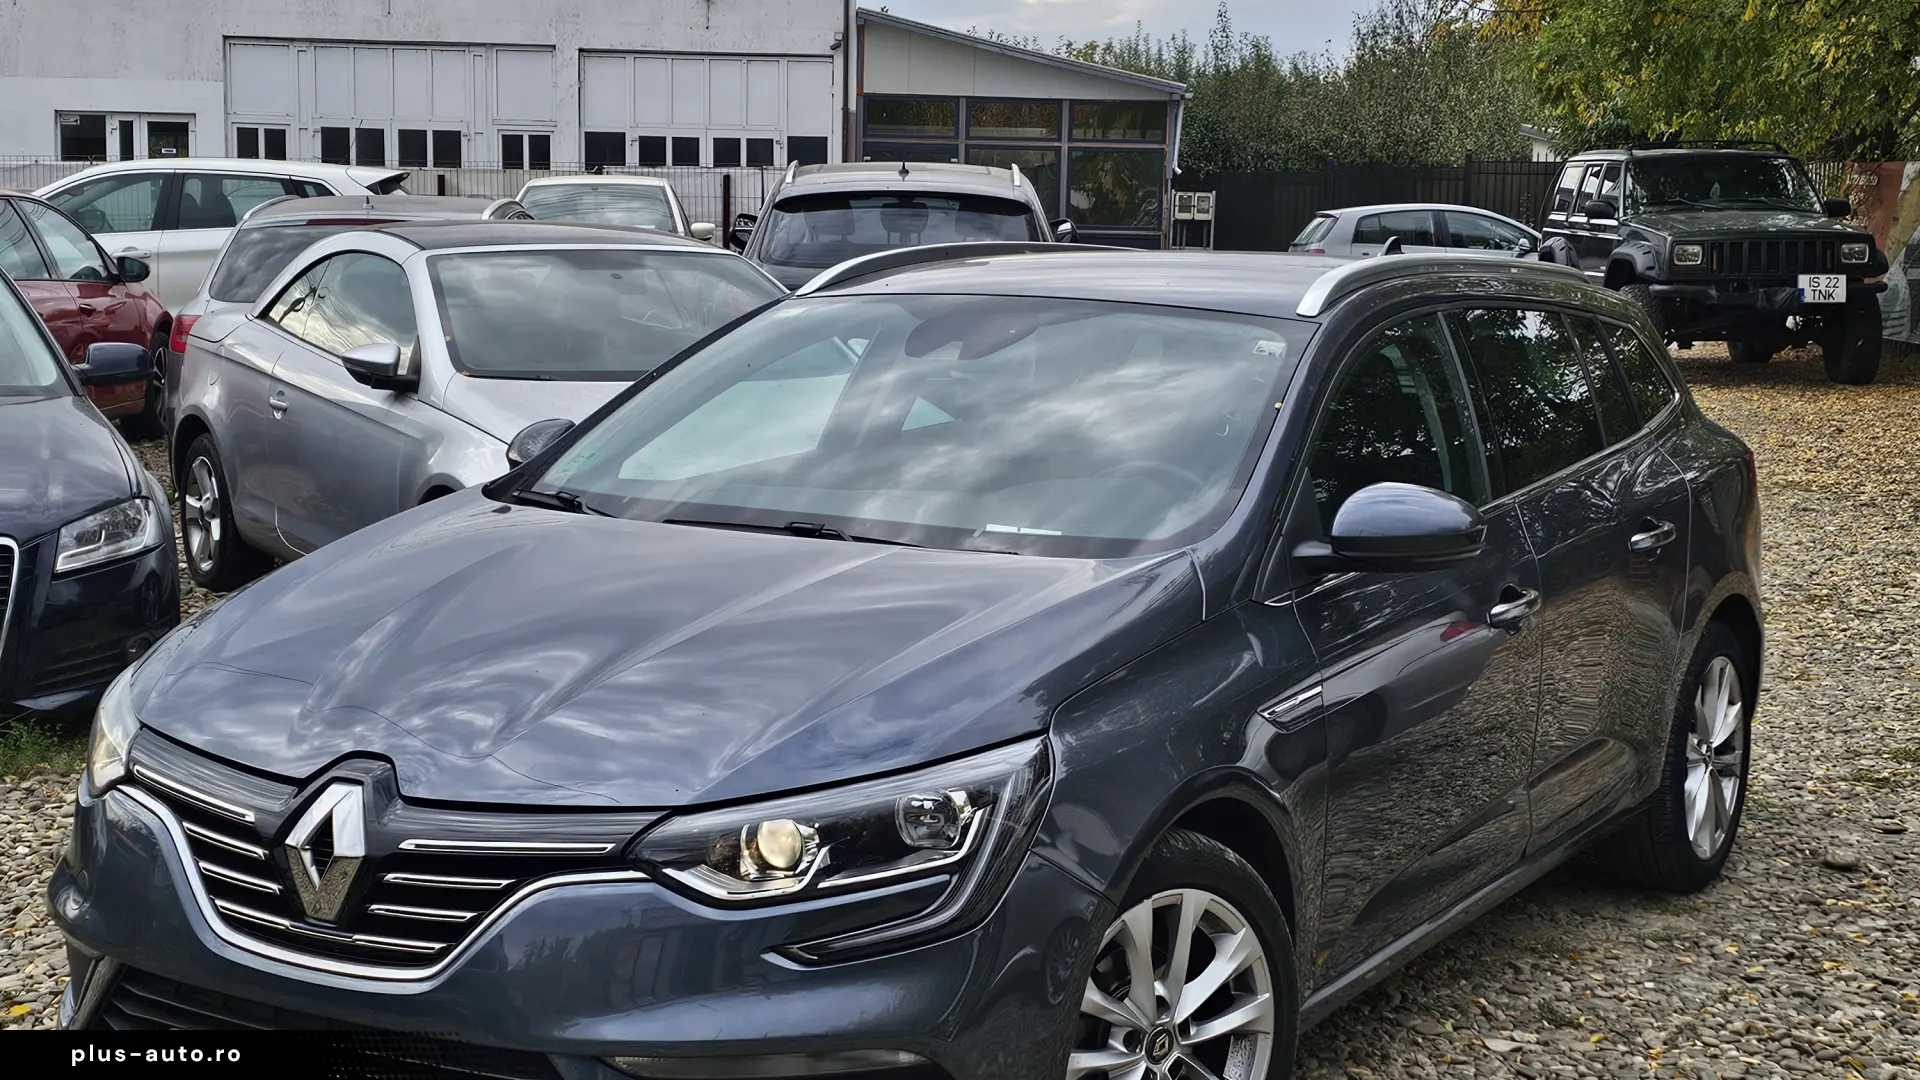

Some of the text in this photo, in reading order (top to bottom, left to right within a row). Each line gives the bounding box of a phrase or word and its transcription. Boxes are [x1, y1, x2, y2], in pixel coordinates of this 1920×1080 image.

[1808, 276, 1840, 289] IS 22
[1811, 289, 1836, 301] TNK
